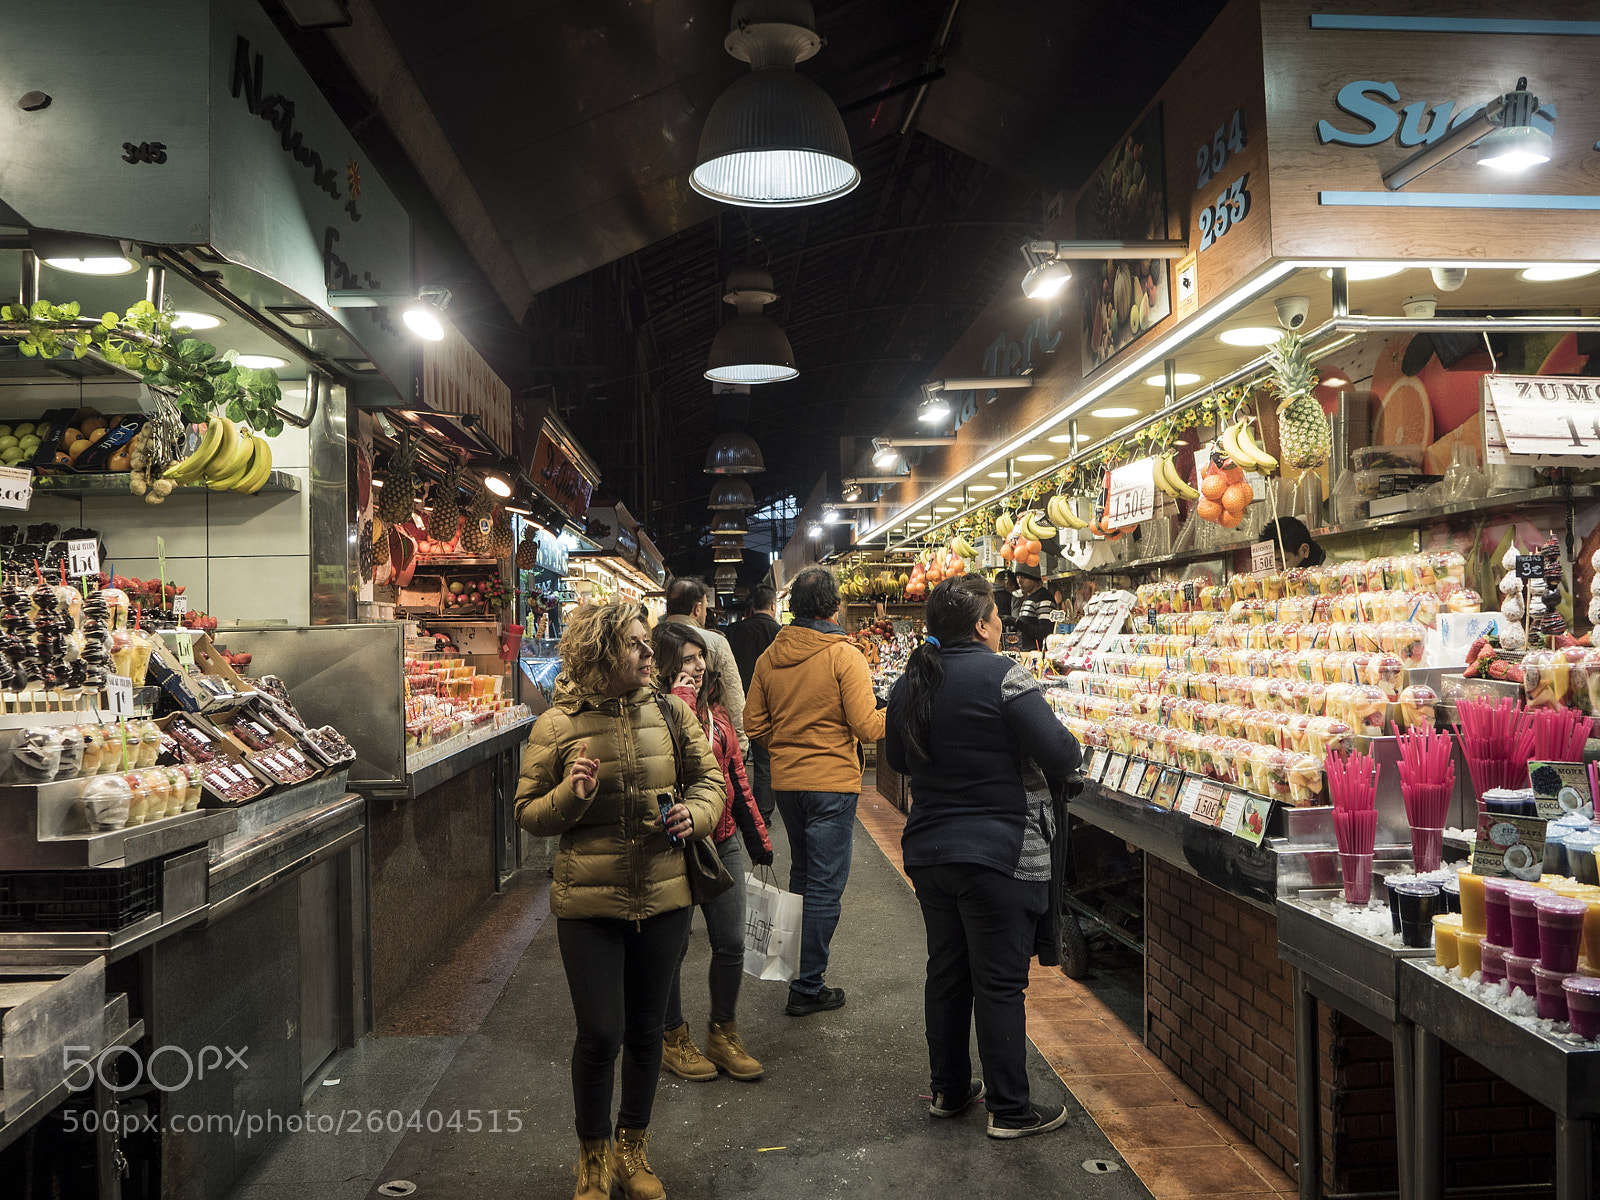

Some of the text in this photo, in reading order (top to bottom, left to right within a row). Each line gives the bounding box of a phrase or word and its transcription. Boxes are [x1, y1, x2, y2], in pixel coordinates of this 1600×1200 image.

[1318, 80, 1557, 148] Su
[121, 141, 168, 165] 345
[1197, 108, 1246, 190] 254
[1199, 174, 1249, 252] 253
[1557, 768, 1585, 776] MORA
[1477, 857, 1502, 866] COCO
